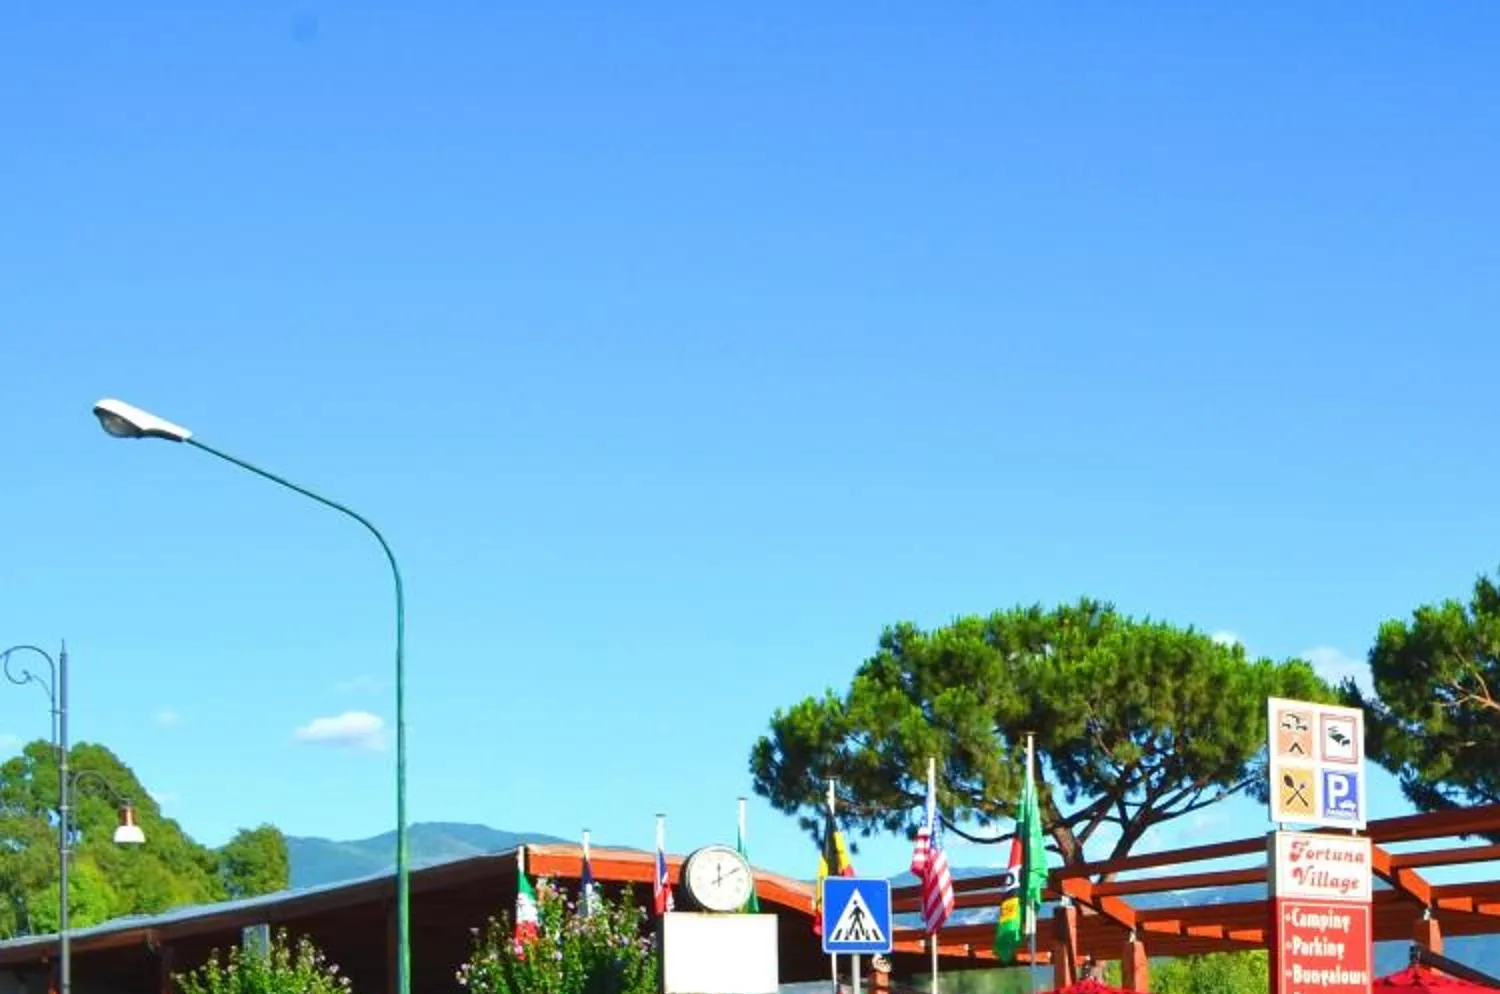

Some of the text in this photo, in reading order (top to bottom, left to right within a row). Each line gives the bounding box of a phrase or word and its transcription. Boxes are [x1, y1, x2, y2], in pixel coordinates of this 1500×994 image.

[1328, 774, 1349, 808] P
[1289, 840, 1365, 864] Fortuna
[1291, 865, 1360, 894] Village
[1291, 907, 1351, 933] Camping
[1291, 935, 1345, 960] Parking
[1292, 963, 1368, 986] Bungalows
